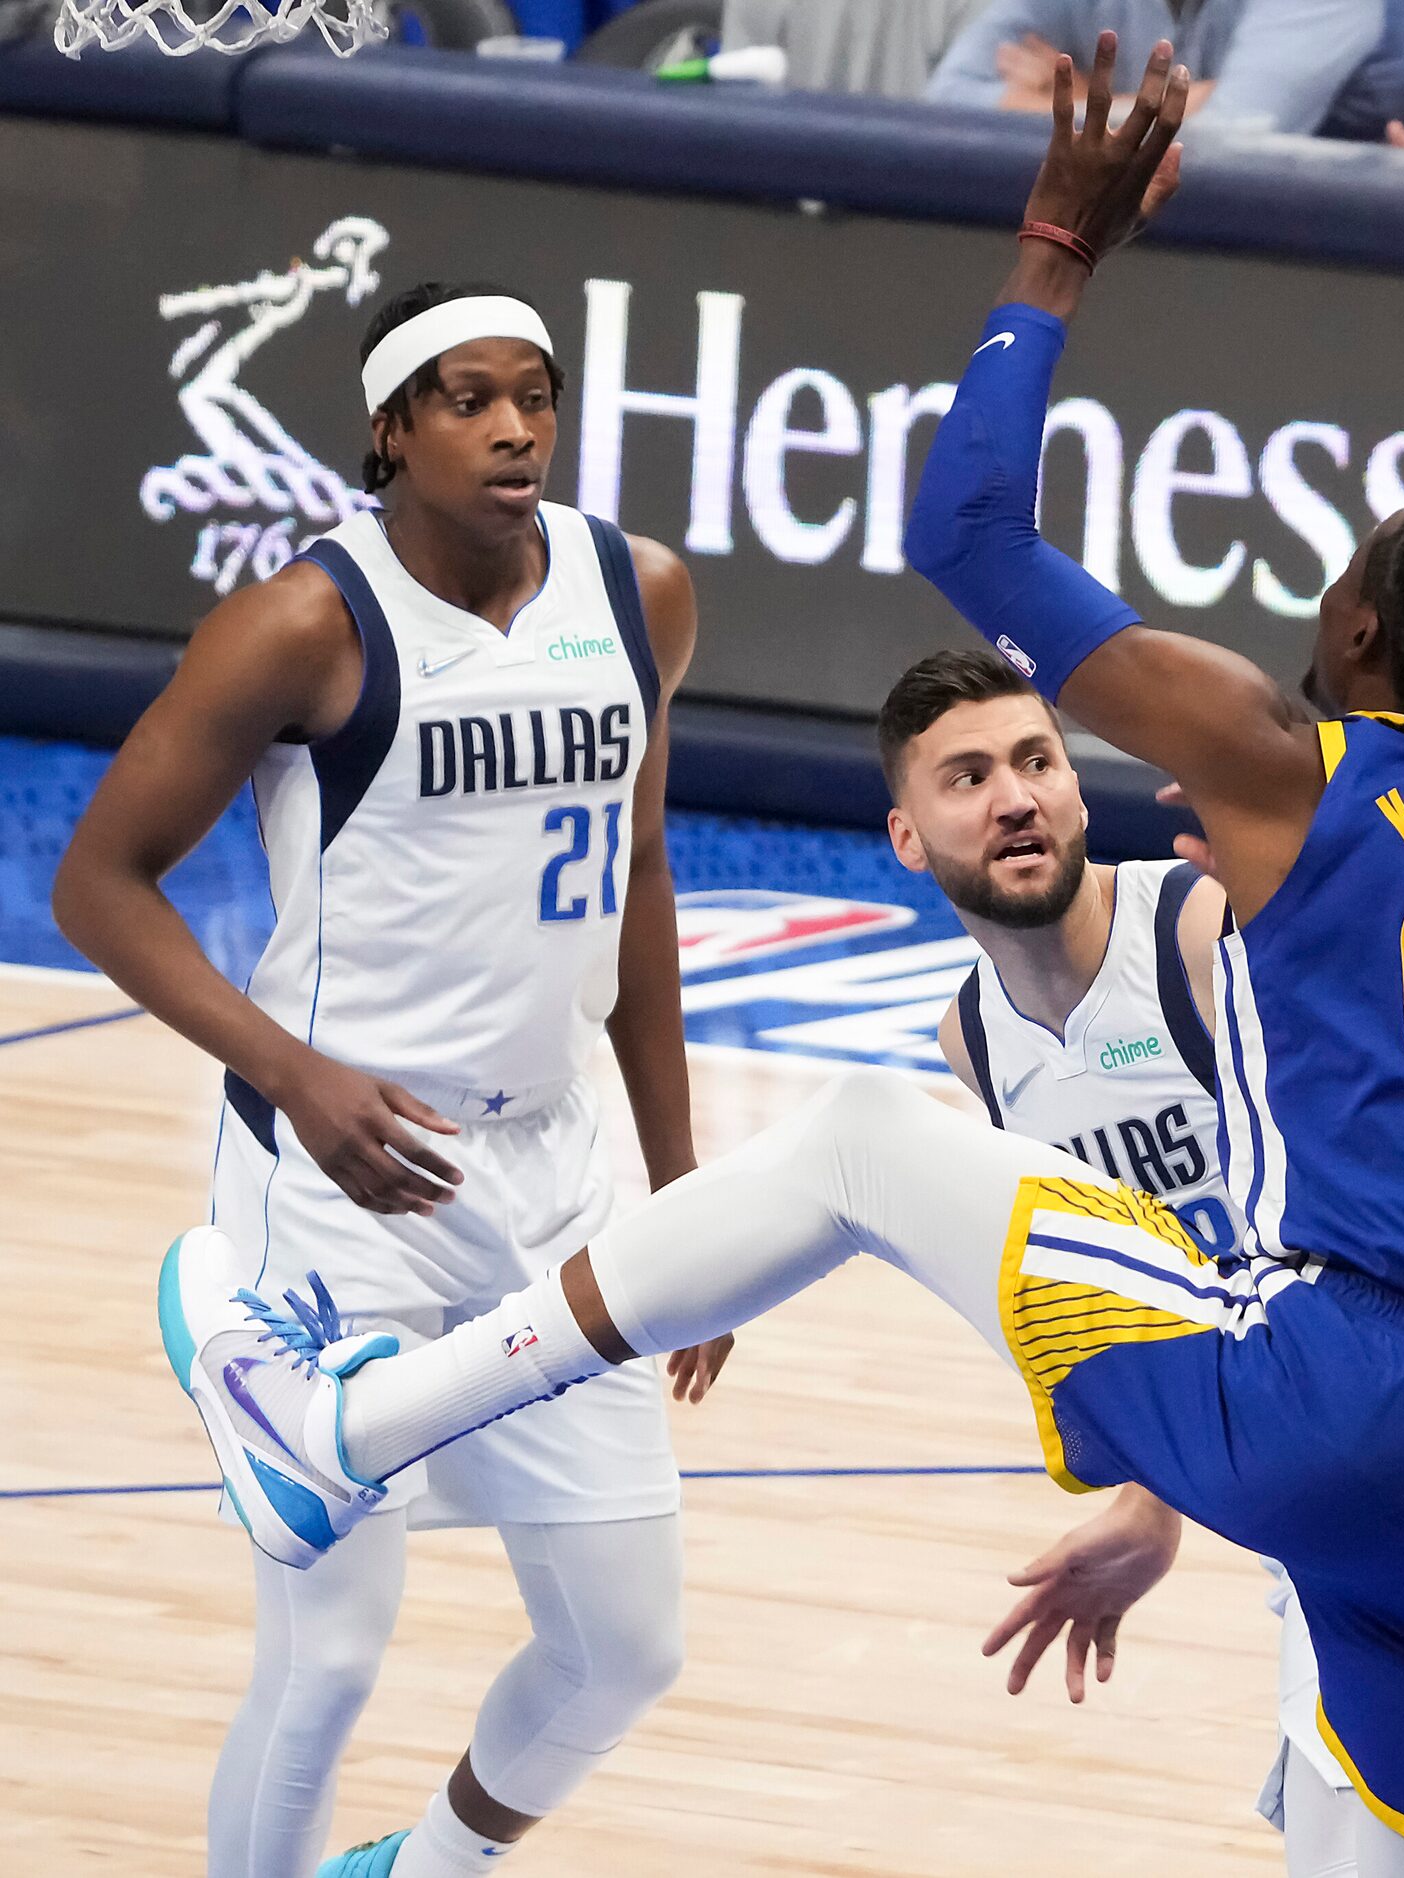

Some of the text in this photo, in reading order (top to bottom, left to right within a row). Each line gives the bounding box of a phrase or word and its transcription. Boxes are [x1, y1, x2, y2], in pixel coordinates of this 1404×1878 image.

[190, 516, 323, 597] 176
[548, 634, 617, 661] chime
[417, 703, 631, 801] DALLAS
[538, 801, 624, 927] 21
[1100, 1036, 1162, 1070] chime
